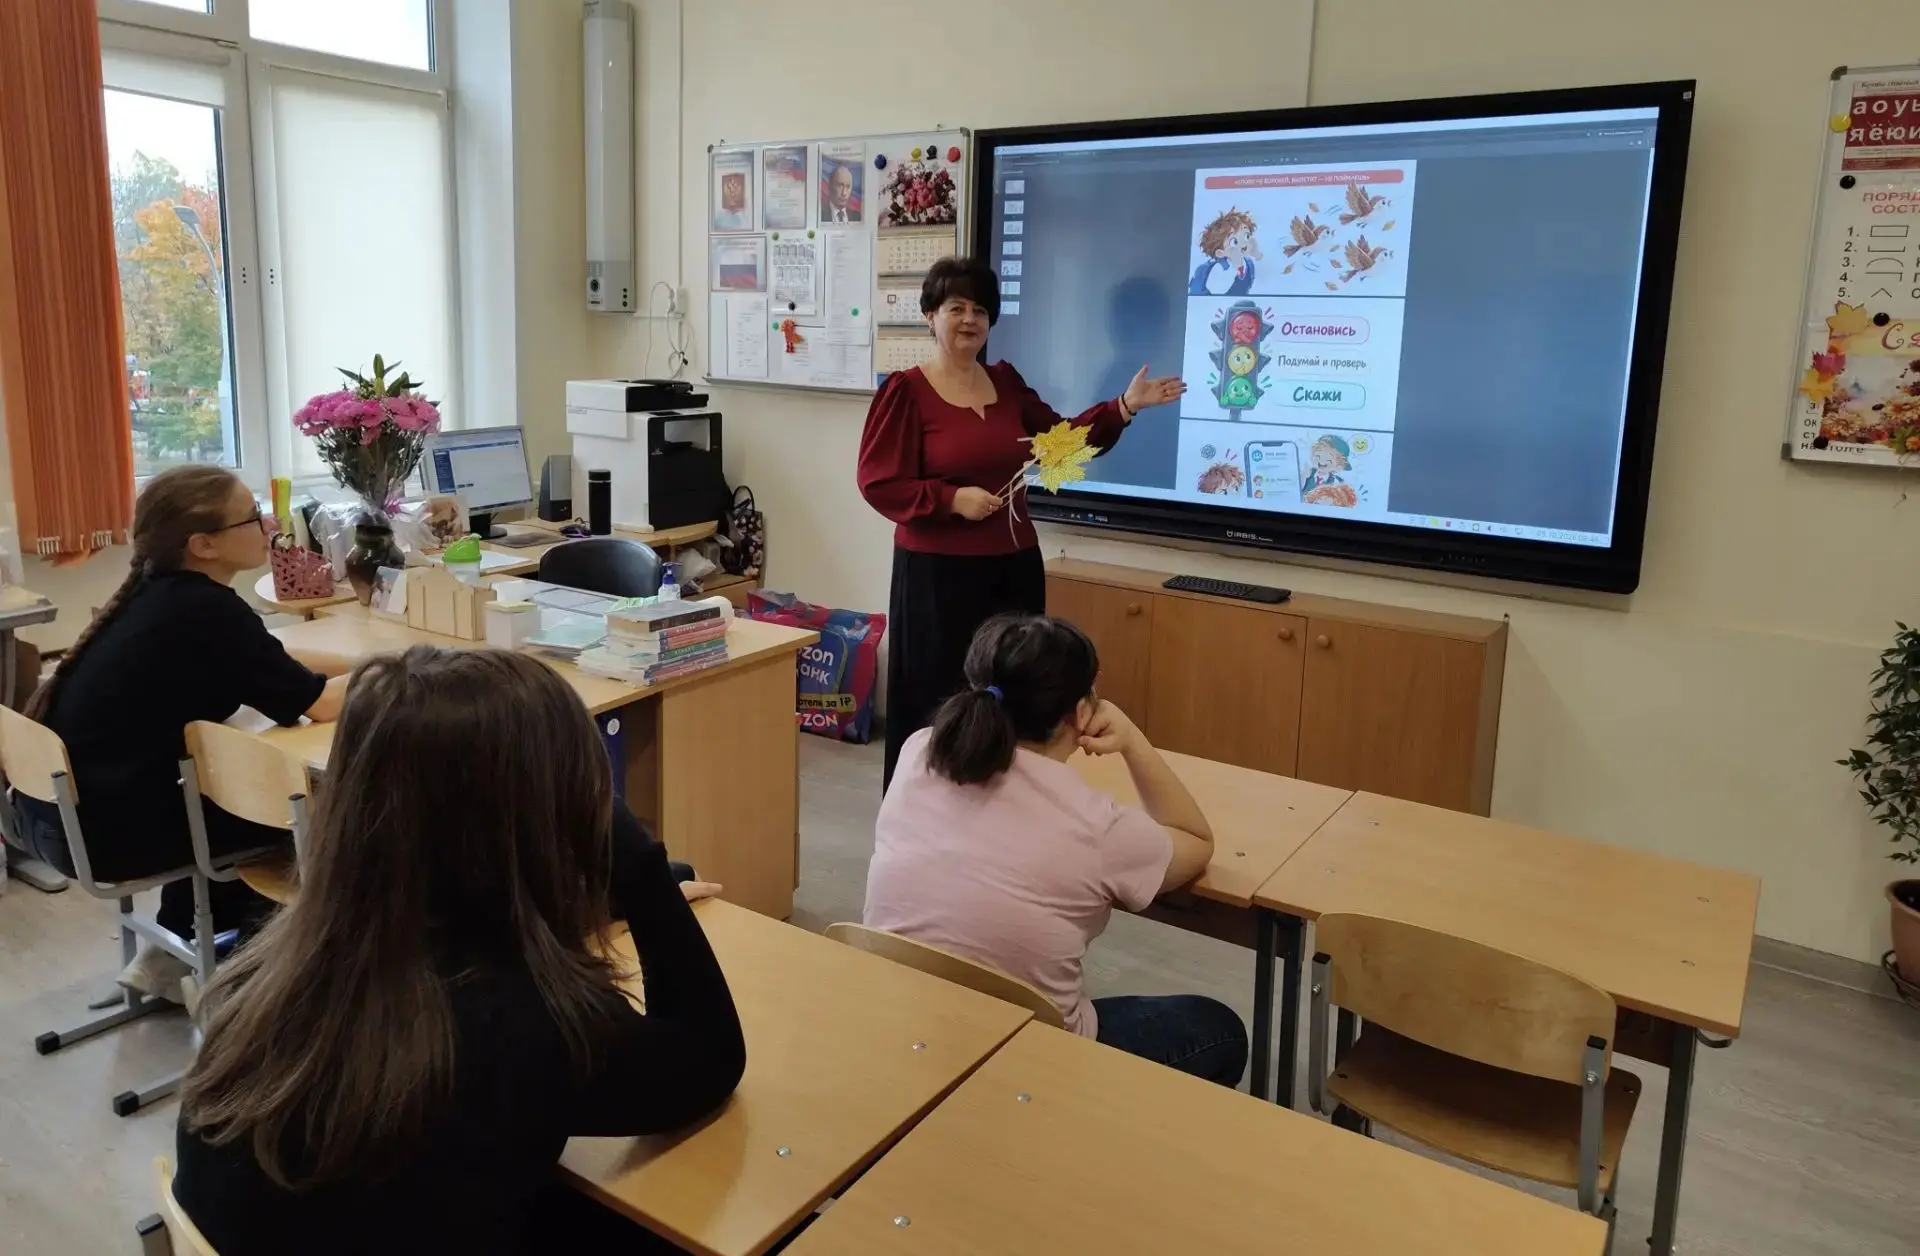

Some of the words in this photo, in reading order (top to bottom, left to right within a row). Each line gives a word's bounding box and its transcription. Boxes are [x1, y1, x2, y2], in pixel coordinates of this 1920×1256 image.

[1872, 204, 1920, 214] СОСТ
[1281, 321, 1356, 337] Остановись
[1278, 354, 1320, 370] Подумай
[1322, 359, 1329, 367] и
[1330, 358, 1367, 370] проверь
[1293, 385, 1342, 402] Скажи
[799, 646, 834, 667] zon
[797, 663, 831, 686] анк
